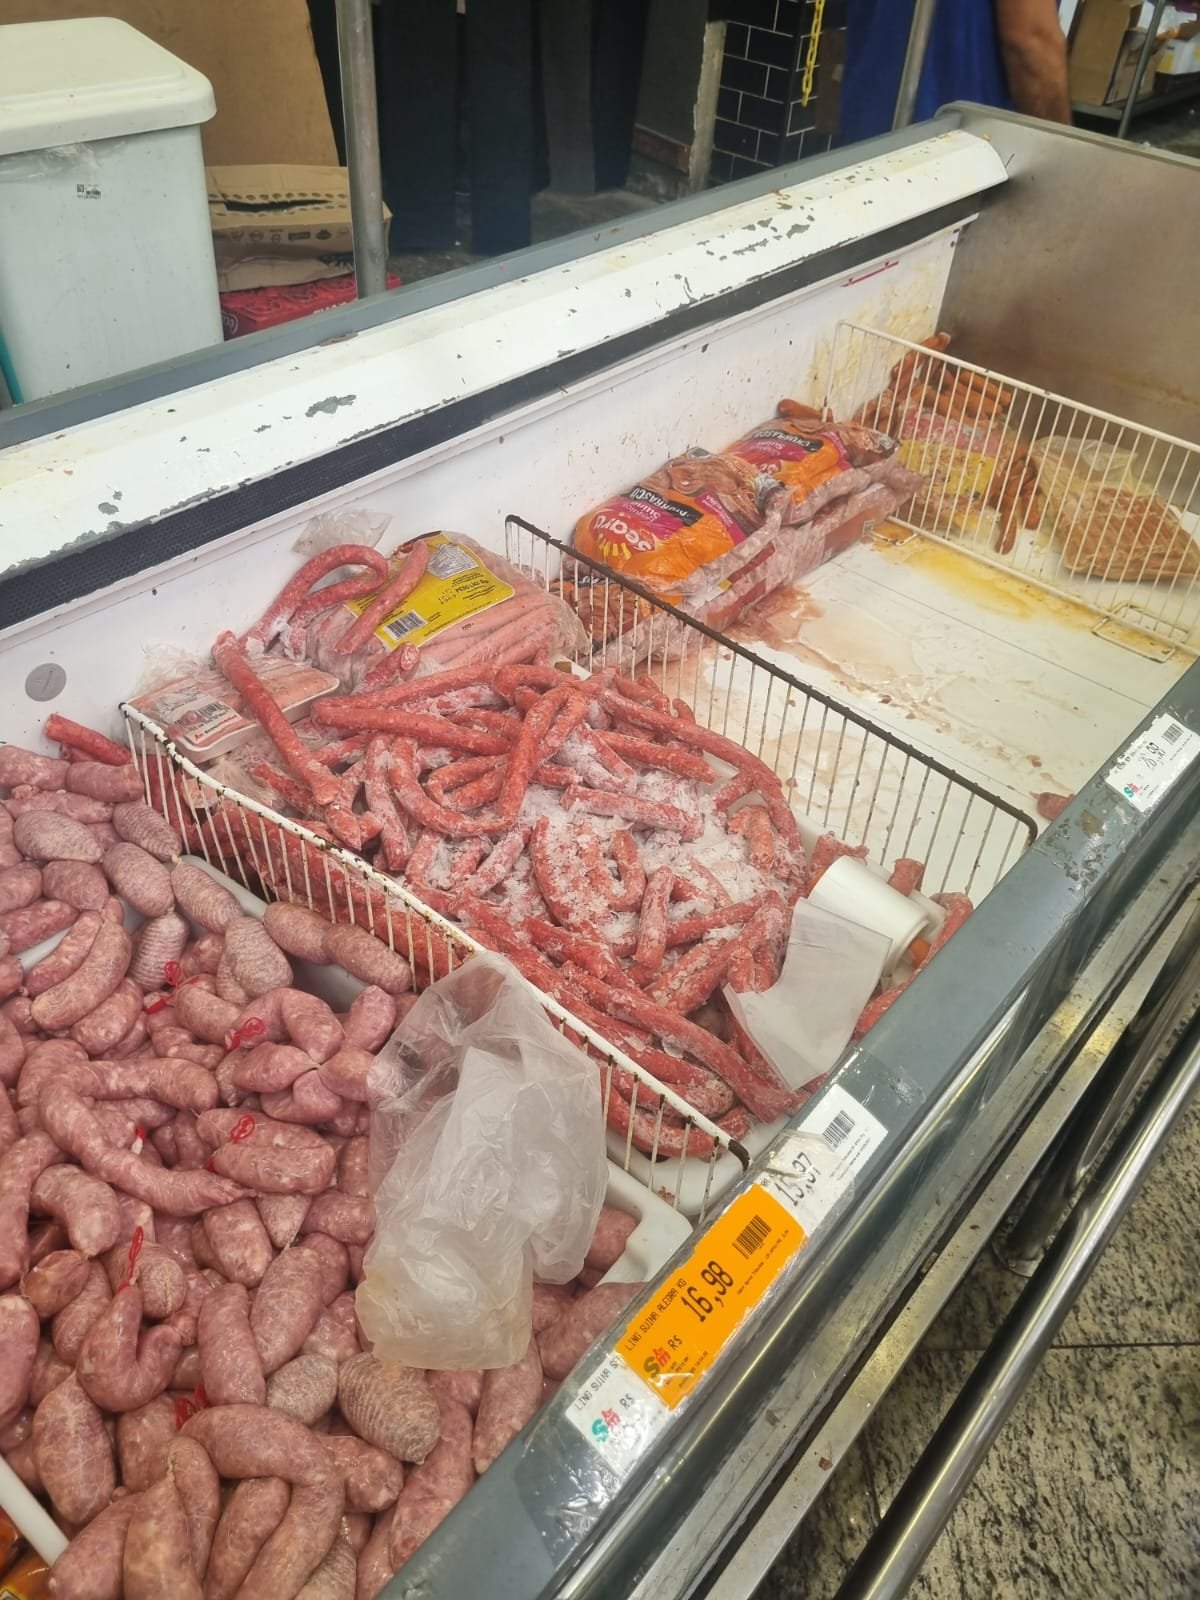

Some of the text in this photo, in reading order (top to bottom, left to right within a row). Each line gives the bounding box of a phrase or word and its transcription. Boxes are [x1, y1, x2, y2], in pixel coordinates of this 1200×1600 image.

[624, 1278, 688, 1352] LING SUINA ALEGRA KG
[680, 1260, 734, 1323] 16,98
[574, 1389, 594, 1411] LING
